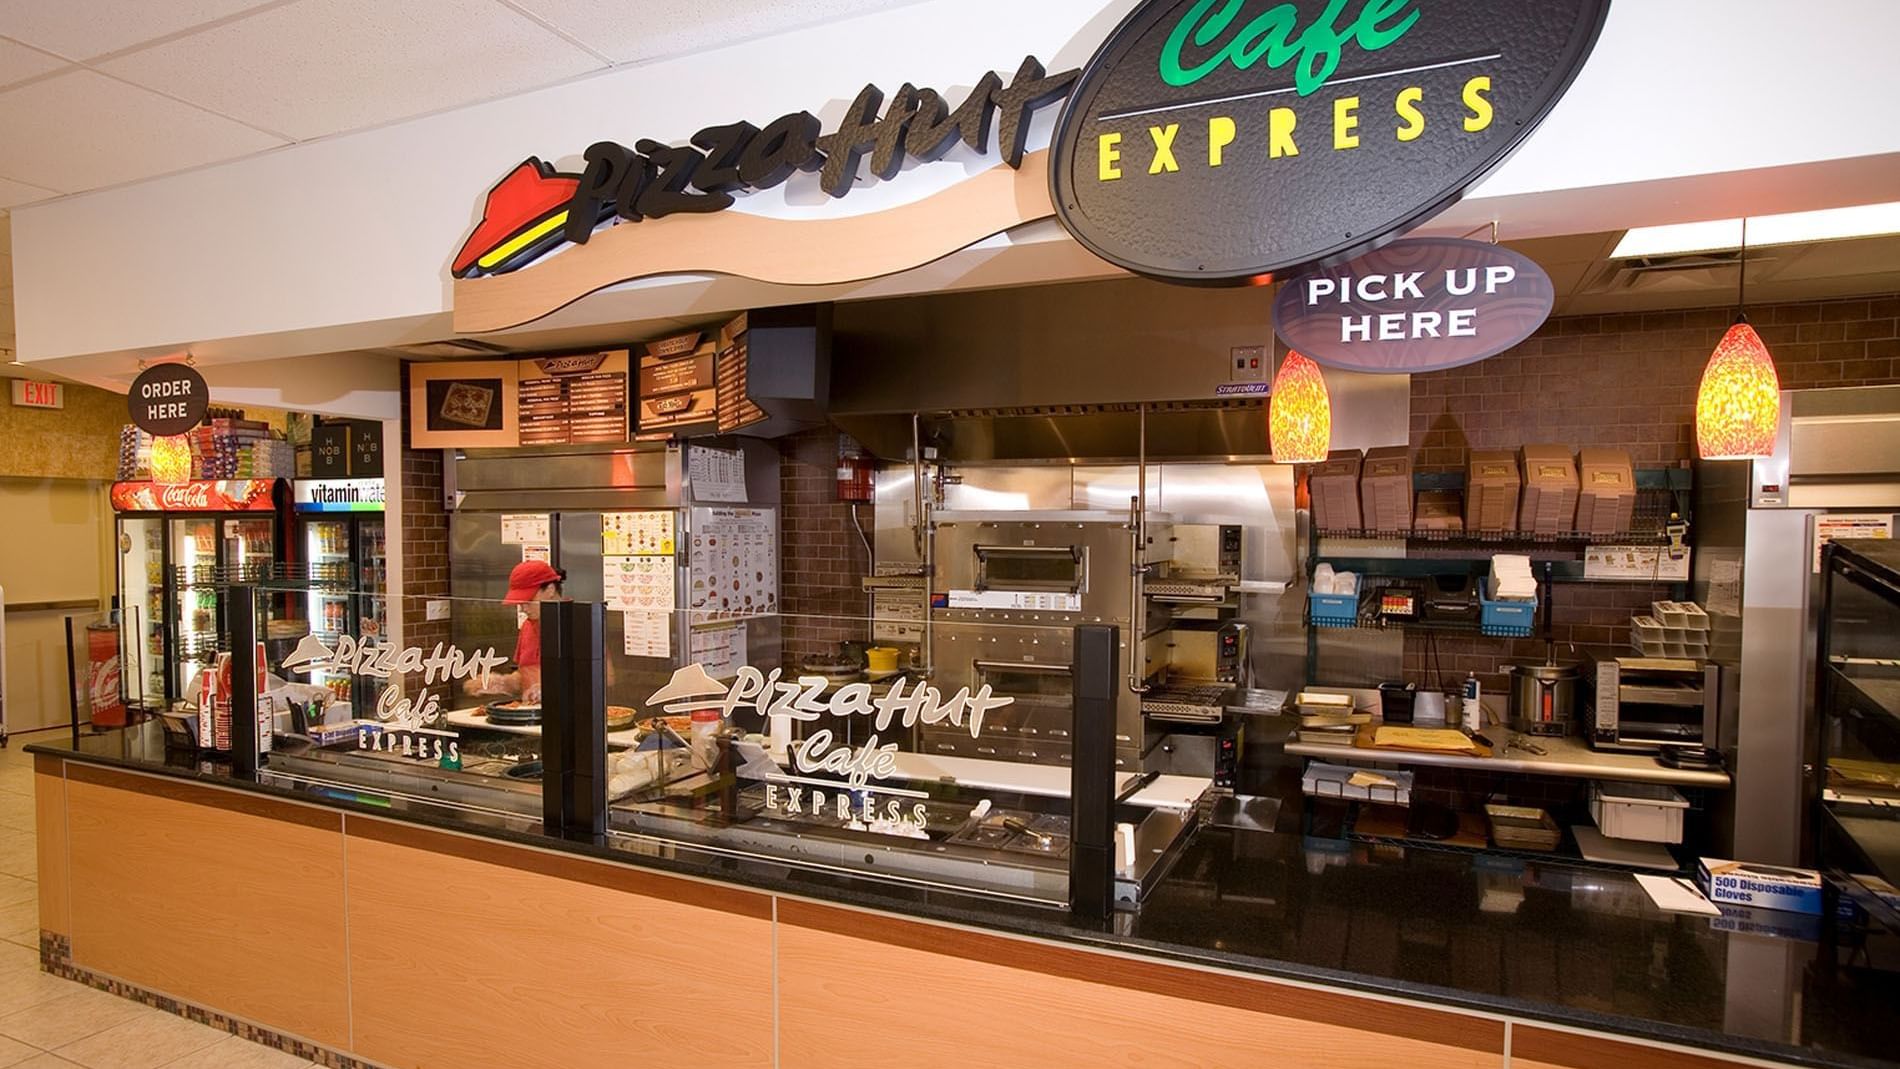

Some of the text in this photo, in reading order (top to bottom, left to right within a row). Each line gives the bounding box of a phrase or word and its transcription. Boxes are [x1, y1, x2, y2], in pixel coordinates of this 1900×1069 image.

[1098, 76, 1494, 181] EXPRESS
[565, 55, 1082, 243] Pizza Hut
[1307, 265, 1516, 305] PICK UP
[1340, 308, 1477, 342] HERE
[24, 382, 57, 406] EXIT
[142, 379, 191, 398] ORDER
[148, 403, 187, 420] HERE
[331, 634, 509, 690] Pizza Hut
[723, 666, 1015, 739] Pizza Hut
[358, 729, 459, 762] EXPRESS
[765, 784, 927, 831] EXPRESS
[1715, 876, 1737, 889] 500
[1740, 880, 1805, 898] Disposable
[1715, 887, 1753, 902] Gloves
